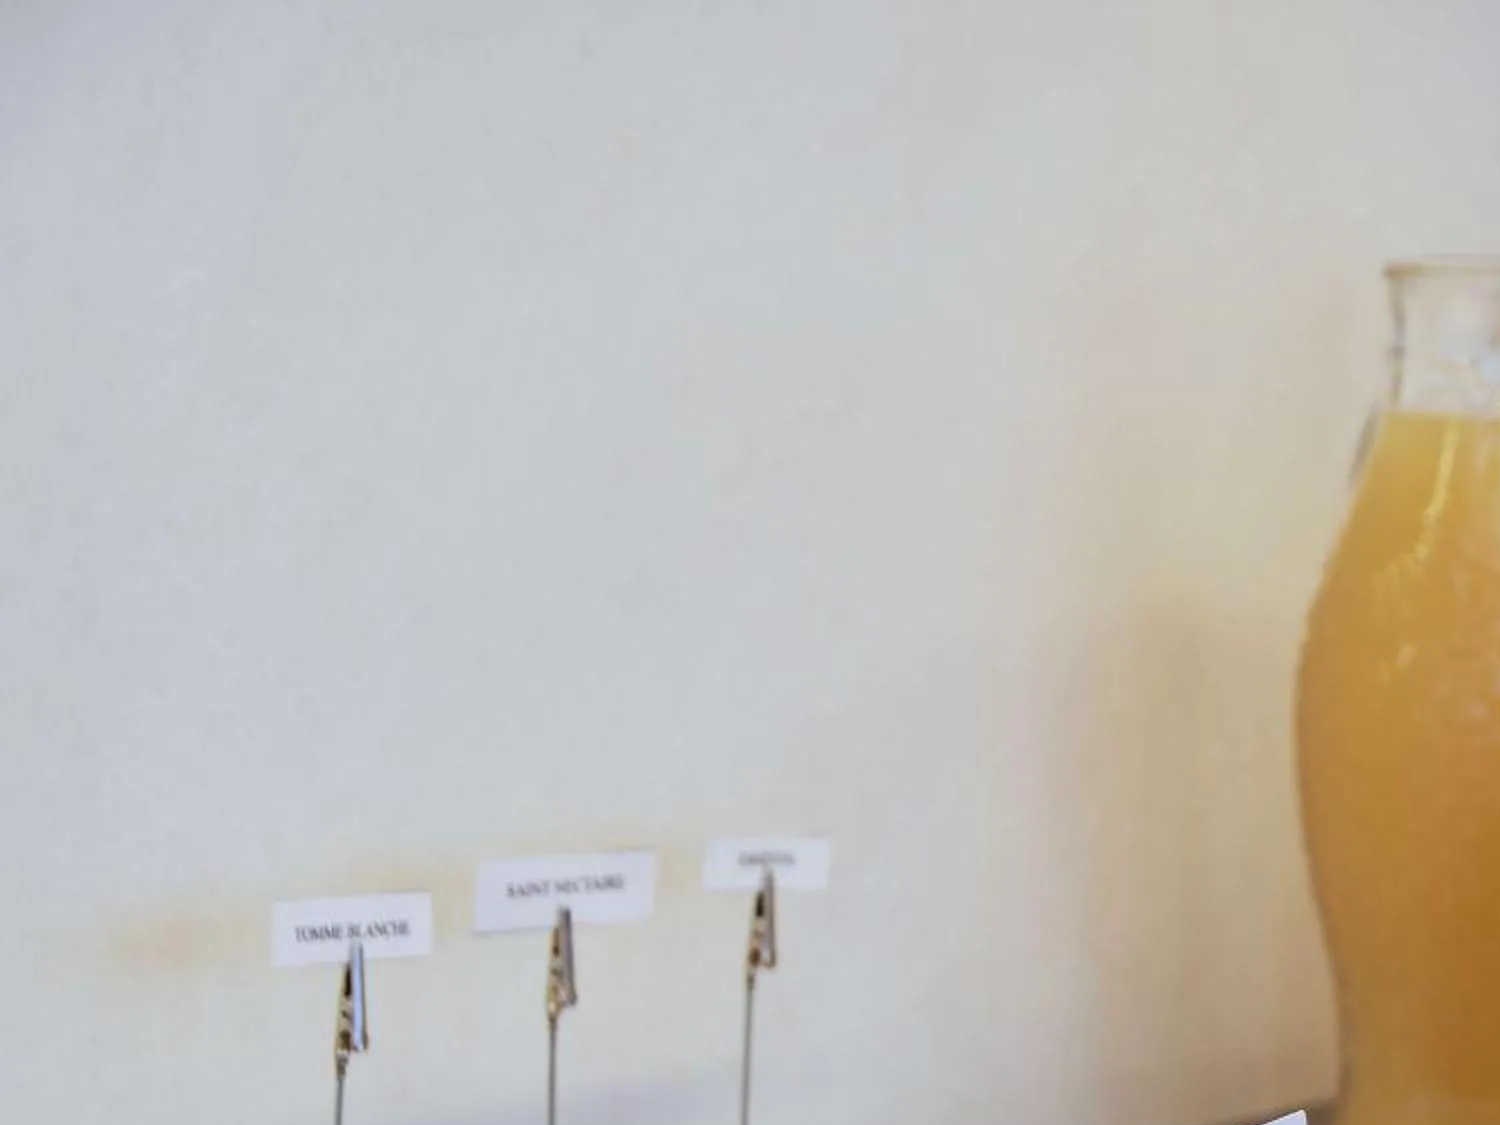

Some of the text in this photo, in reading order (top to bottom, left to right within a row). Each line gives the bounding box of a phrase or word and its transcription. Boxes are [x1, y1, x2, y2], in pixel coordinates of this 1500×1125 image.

[505, 877, 551, 899] SAINT
[294, 920, 412, 943] TOMME BLANCHE
